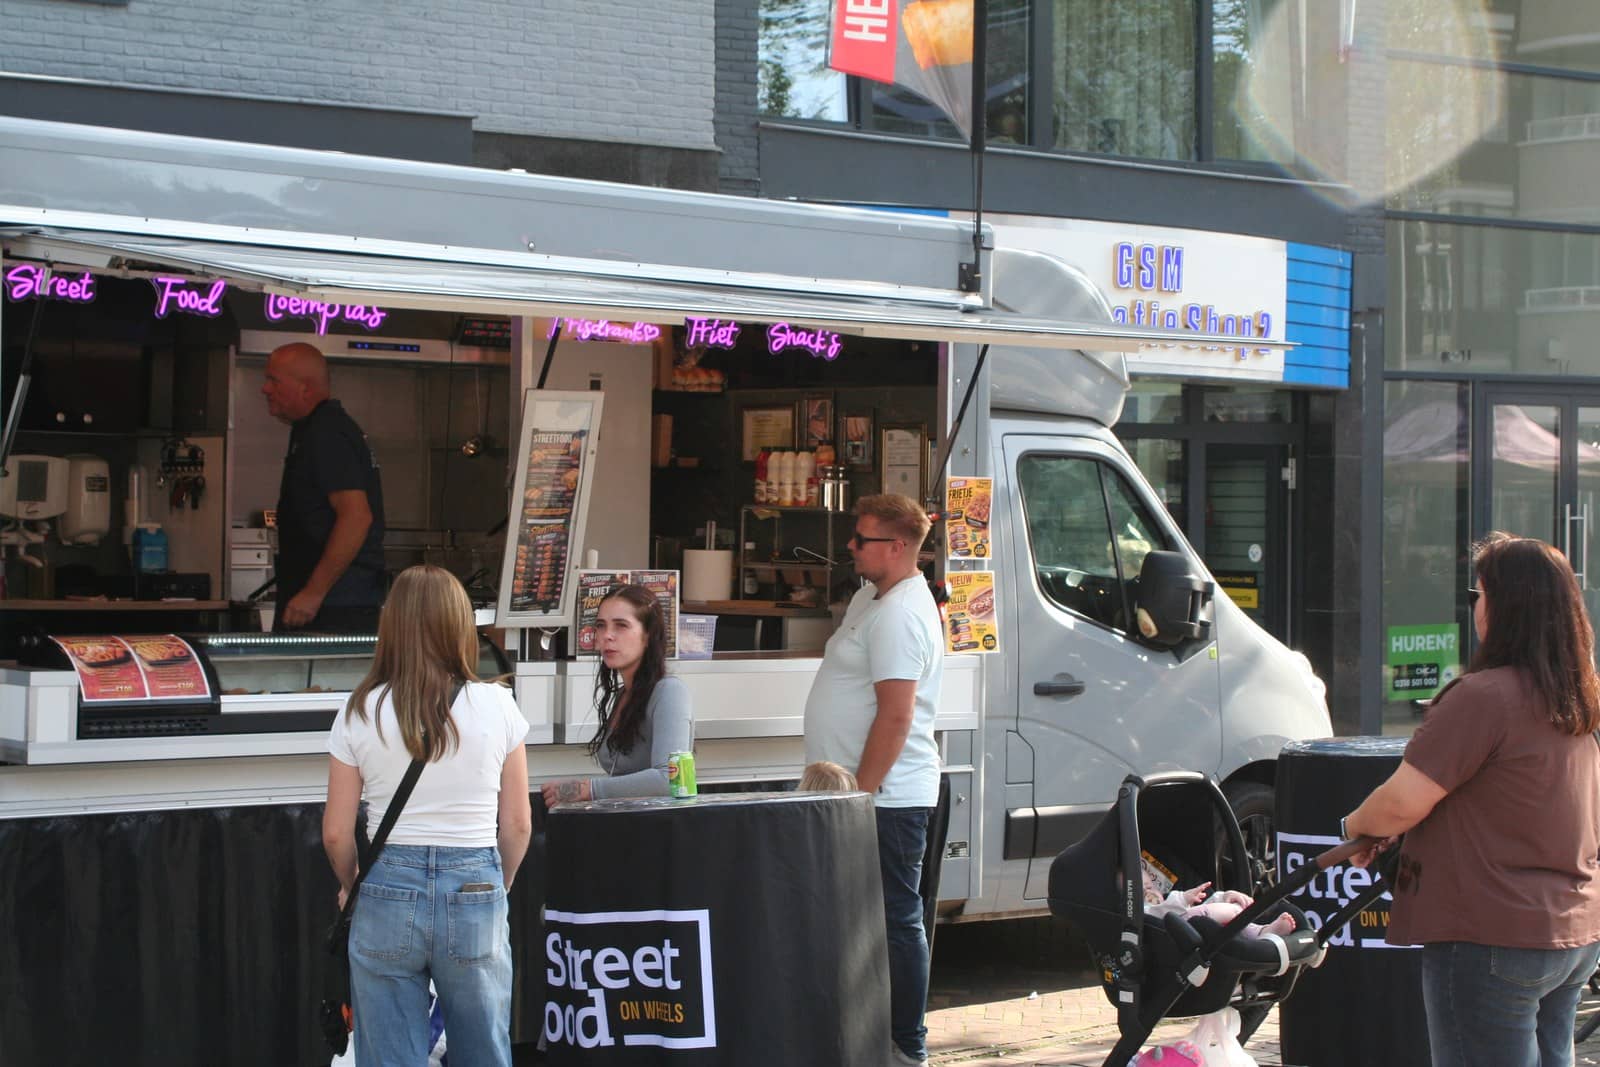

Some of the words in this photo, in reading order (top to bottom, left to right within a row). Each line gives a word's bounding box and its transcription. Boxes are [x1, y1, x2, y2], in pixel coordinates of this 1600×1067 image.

[7, 264, 94, 300] Street
[156, 276, 226, 316] Food
[1114, 241, 1184, 293] GSM
[686, 316, 739, 347] Friet
[769, 321, 841, 358] Snack's
[1391, 633, 1457, 653] HUREN?
[1286, 852, 1394, 900] Stre
[1359, 910, 1378, 928] ON
[545, 931, 682, 990] Street
[543, 987, 616, 1049] ood
[619, 1000, 641, 1020] ON
